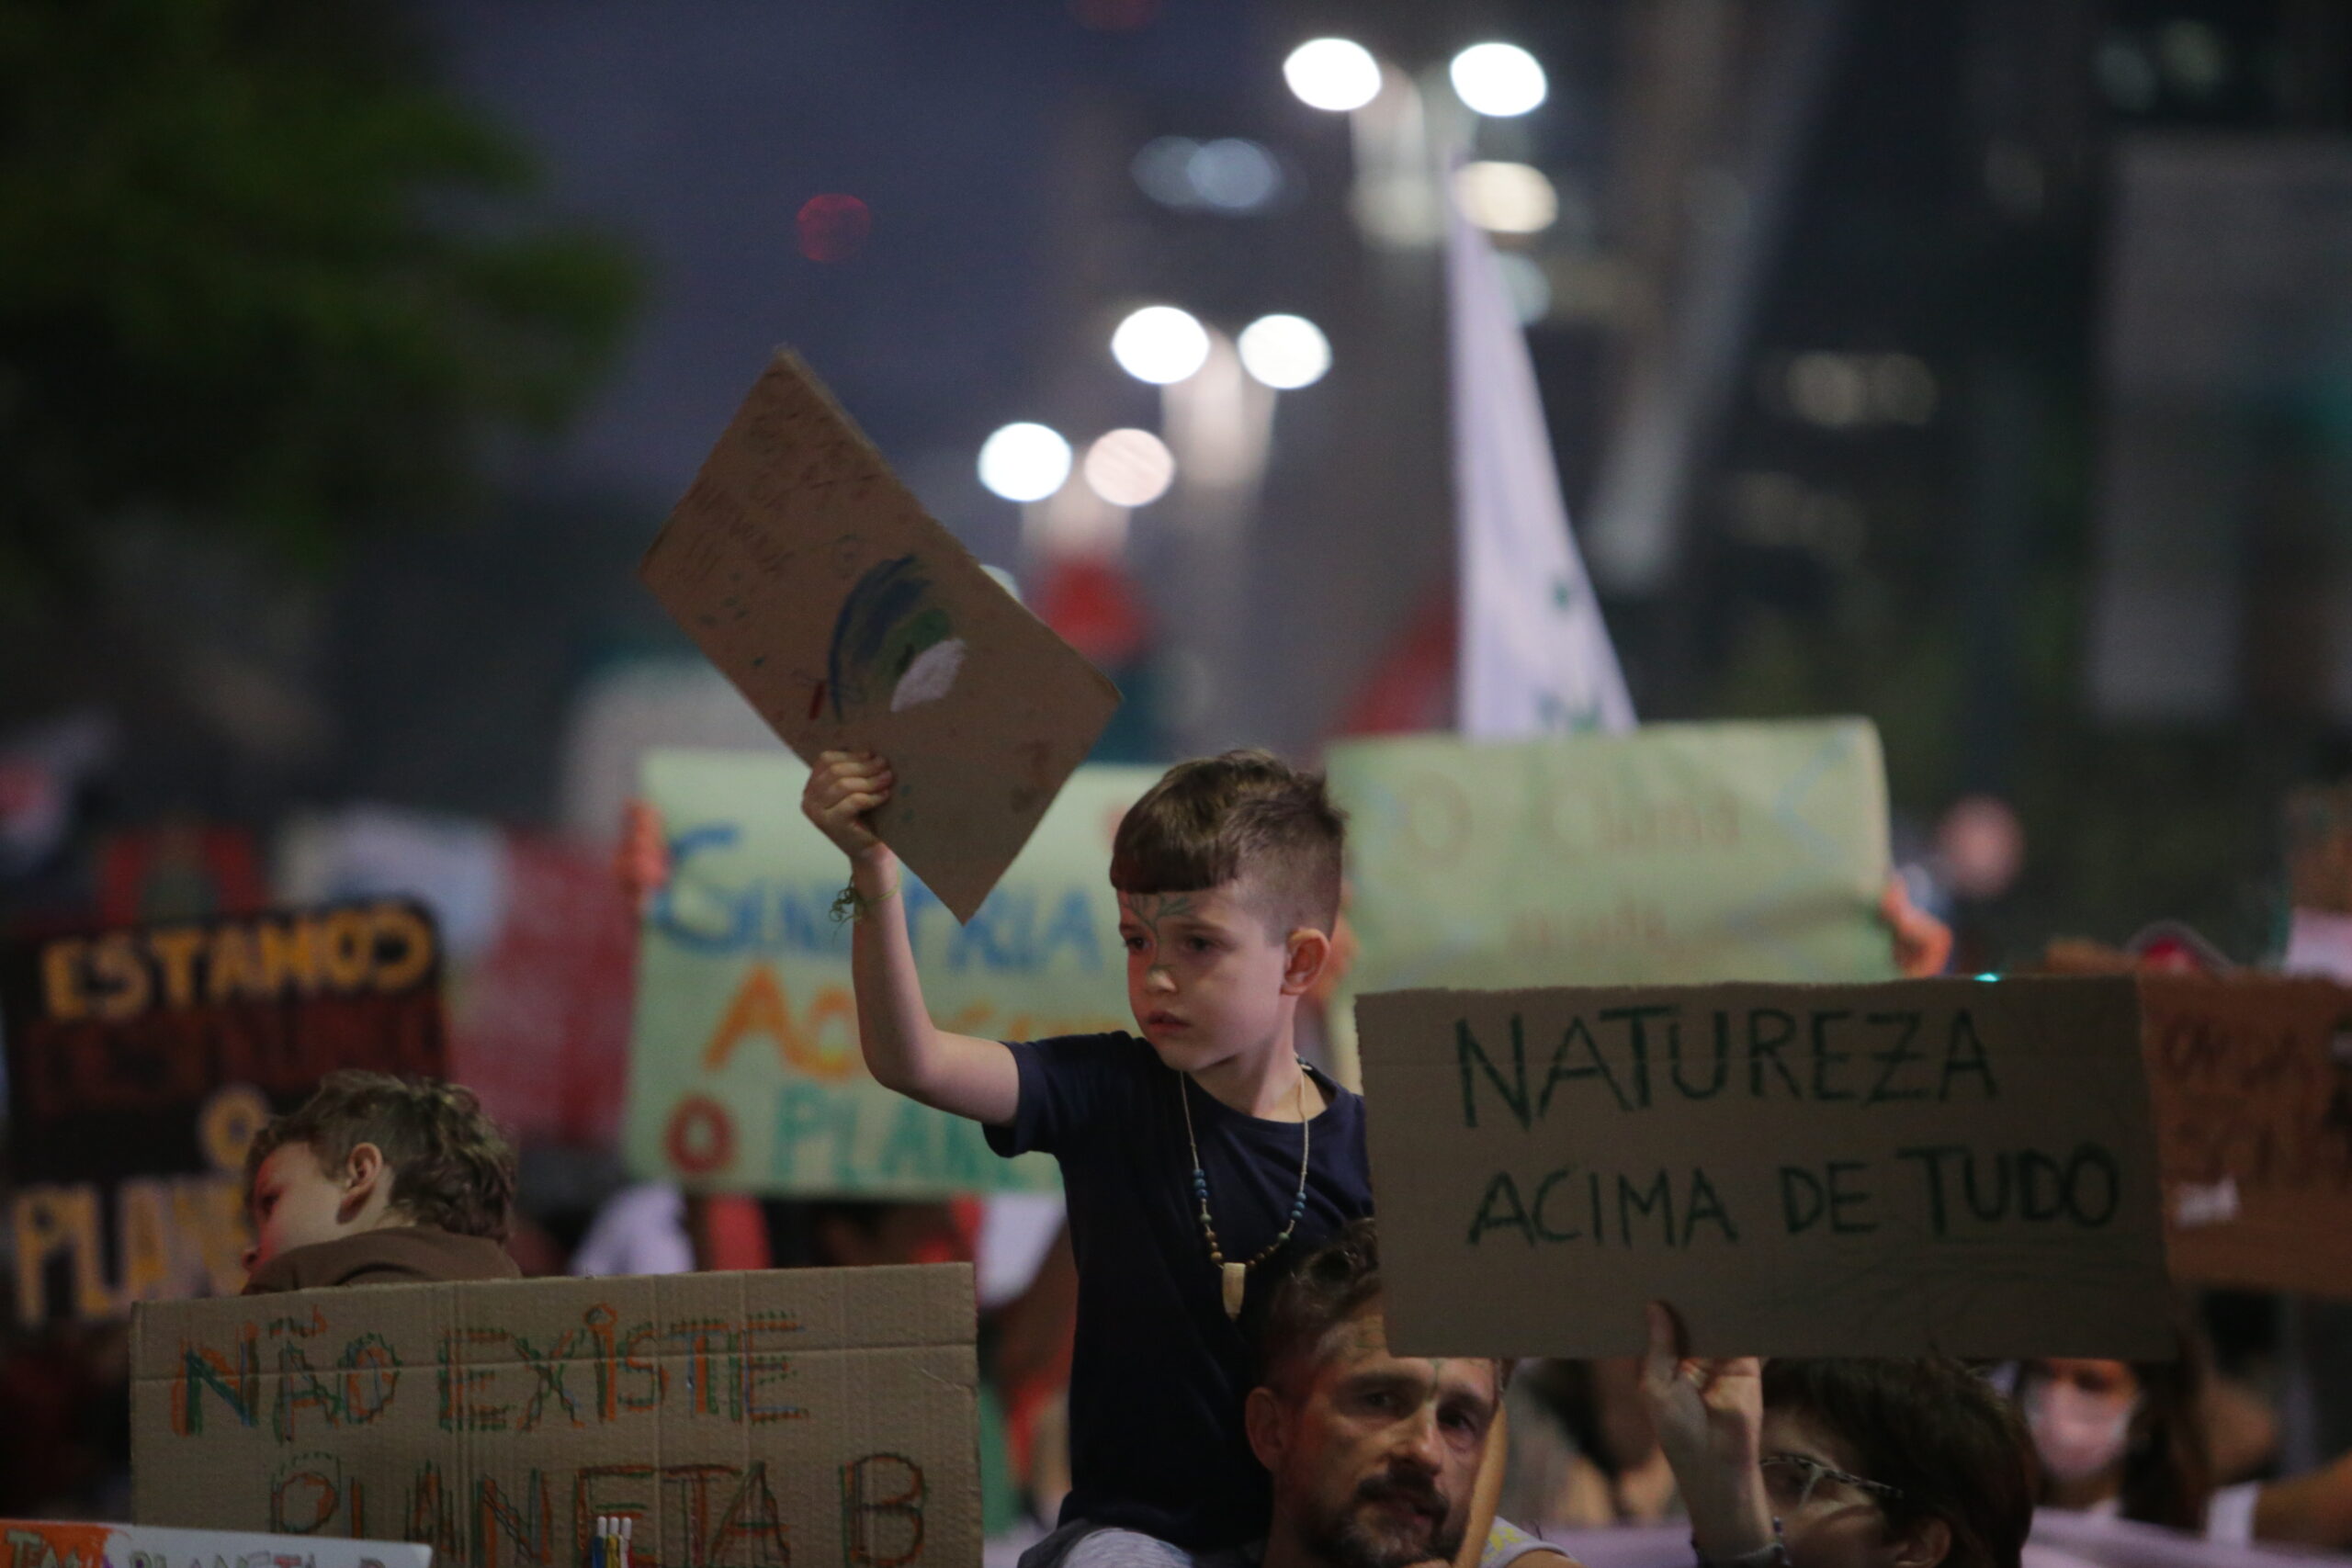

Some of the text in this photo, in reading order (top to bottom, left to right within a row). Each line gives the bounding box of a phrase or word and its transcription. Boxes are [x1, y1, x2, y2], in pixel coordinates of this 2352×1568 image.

[1455, 1003, 1999, 1131] NATUREZA
[1467, 1163, 1739, 1248] ACIMA
[1780, 1161, 1881, 1236] DE
[1897, 1140, 2122, 1237] TUDO
[171, 1303, 809, 1443] NÃO EXISTE
[842, 1450, 926, 1566] B
